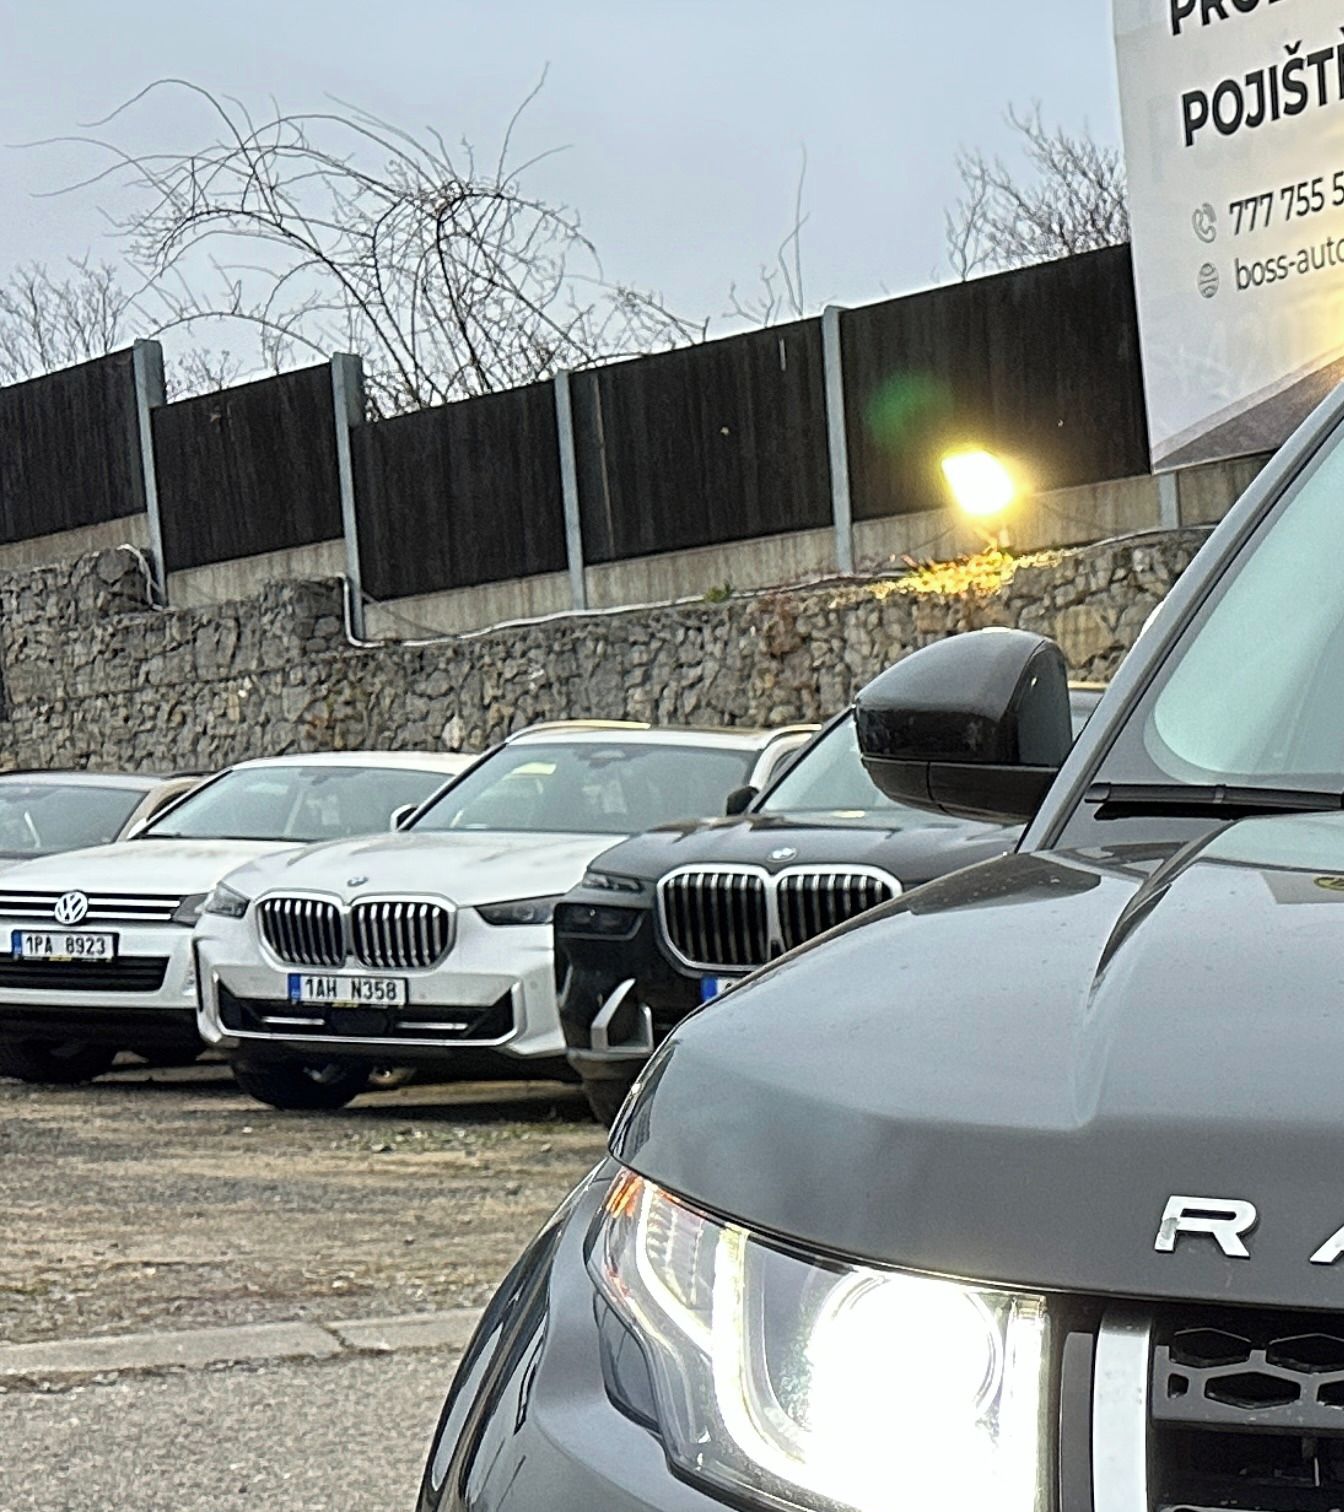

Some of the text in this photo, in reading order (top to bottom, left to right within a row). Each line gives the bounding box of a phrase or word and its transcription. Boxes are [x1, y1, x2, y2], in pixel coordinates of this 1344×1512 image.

[1229, 191, 1273, 235] 777
[1280, 177, 1325, 221] 755
[26, 935, 53, 955] 1PA
[65, 936, 105, 955] 8923
[305, 978, 337, 999] 1AH
[351, 980, 396, 1001] N358
